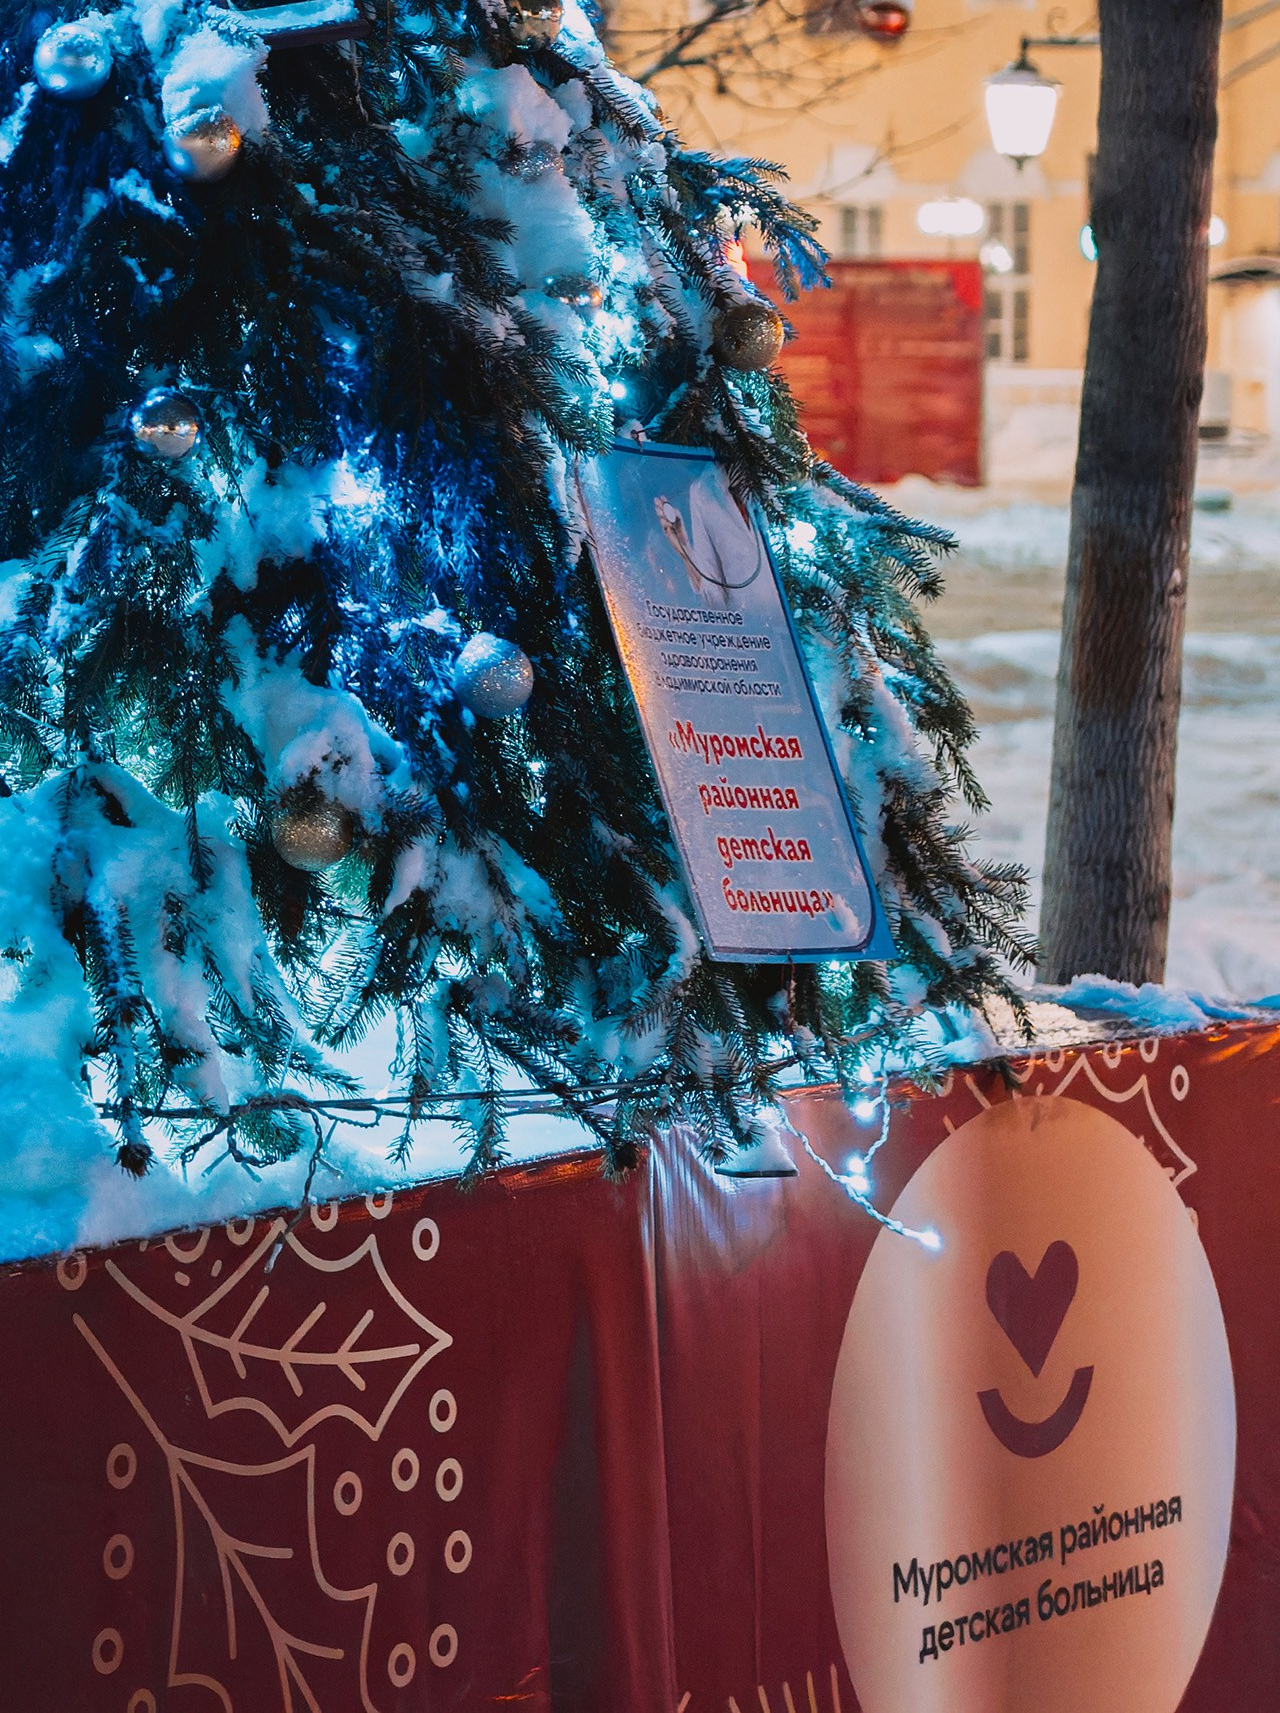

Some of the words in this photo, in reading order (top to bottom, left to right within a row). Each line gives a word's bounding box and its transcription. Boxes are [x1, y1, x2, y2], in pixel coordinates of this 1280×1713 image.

[645, 599, 744, 625] Государственное
[699, 633, 772, 650] учреждение
[661, 651, 759, 673] здравоохранения
[733, 678, 783, 697] области
[669, 721, 803, 765] «Муромская
[698, 776, 800, 815] районная
[717, 827, 813, 869] детская
[722, 877, 835, 918] больница»
[891, 1532, 1054, 1606] Муромская
[1059, 1494, 1183, 1566] районная
[919, 1598, 1031, 1664] детская
[1036, 1558, 1165, 1623] больница
